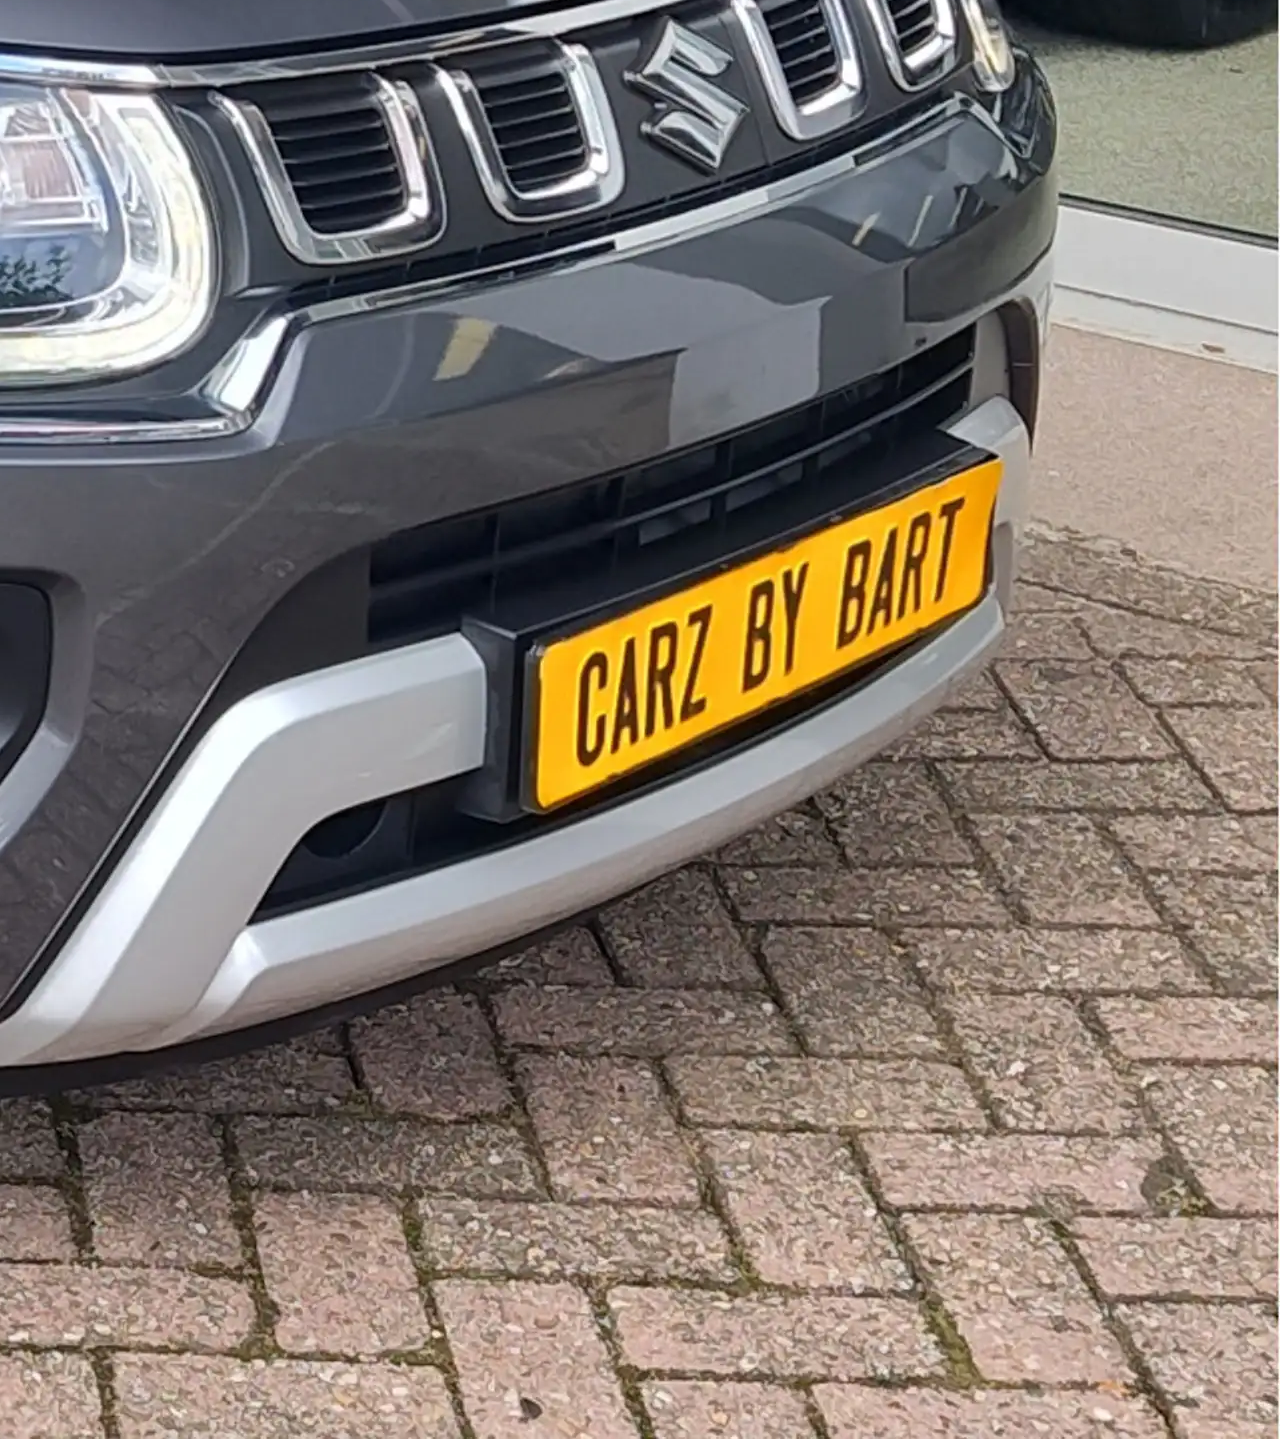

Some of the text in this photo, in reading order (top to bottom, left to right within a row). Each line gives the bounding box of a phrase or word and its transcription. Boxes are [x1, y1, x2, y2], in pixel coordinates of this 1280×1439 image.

[575, 497, 964, 767] CARZ BY BART
